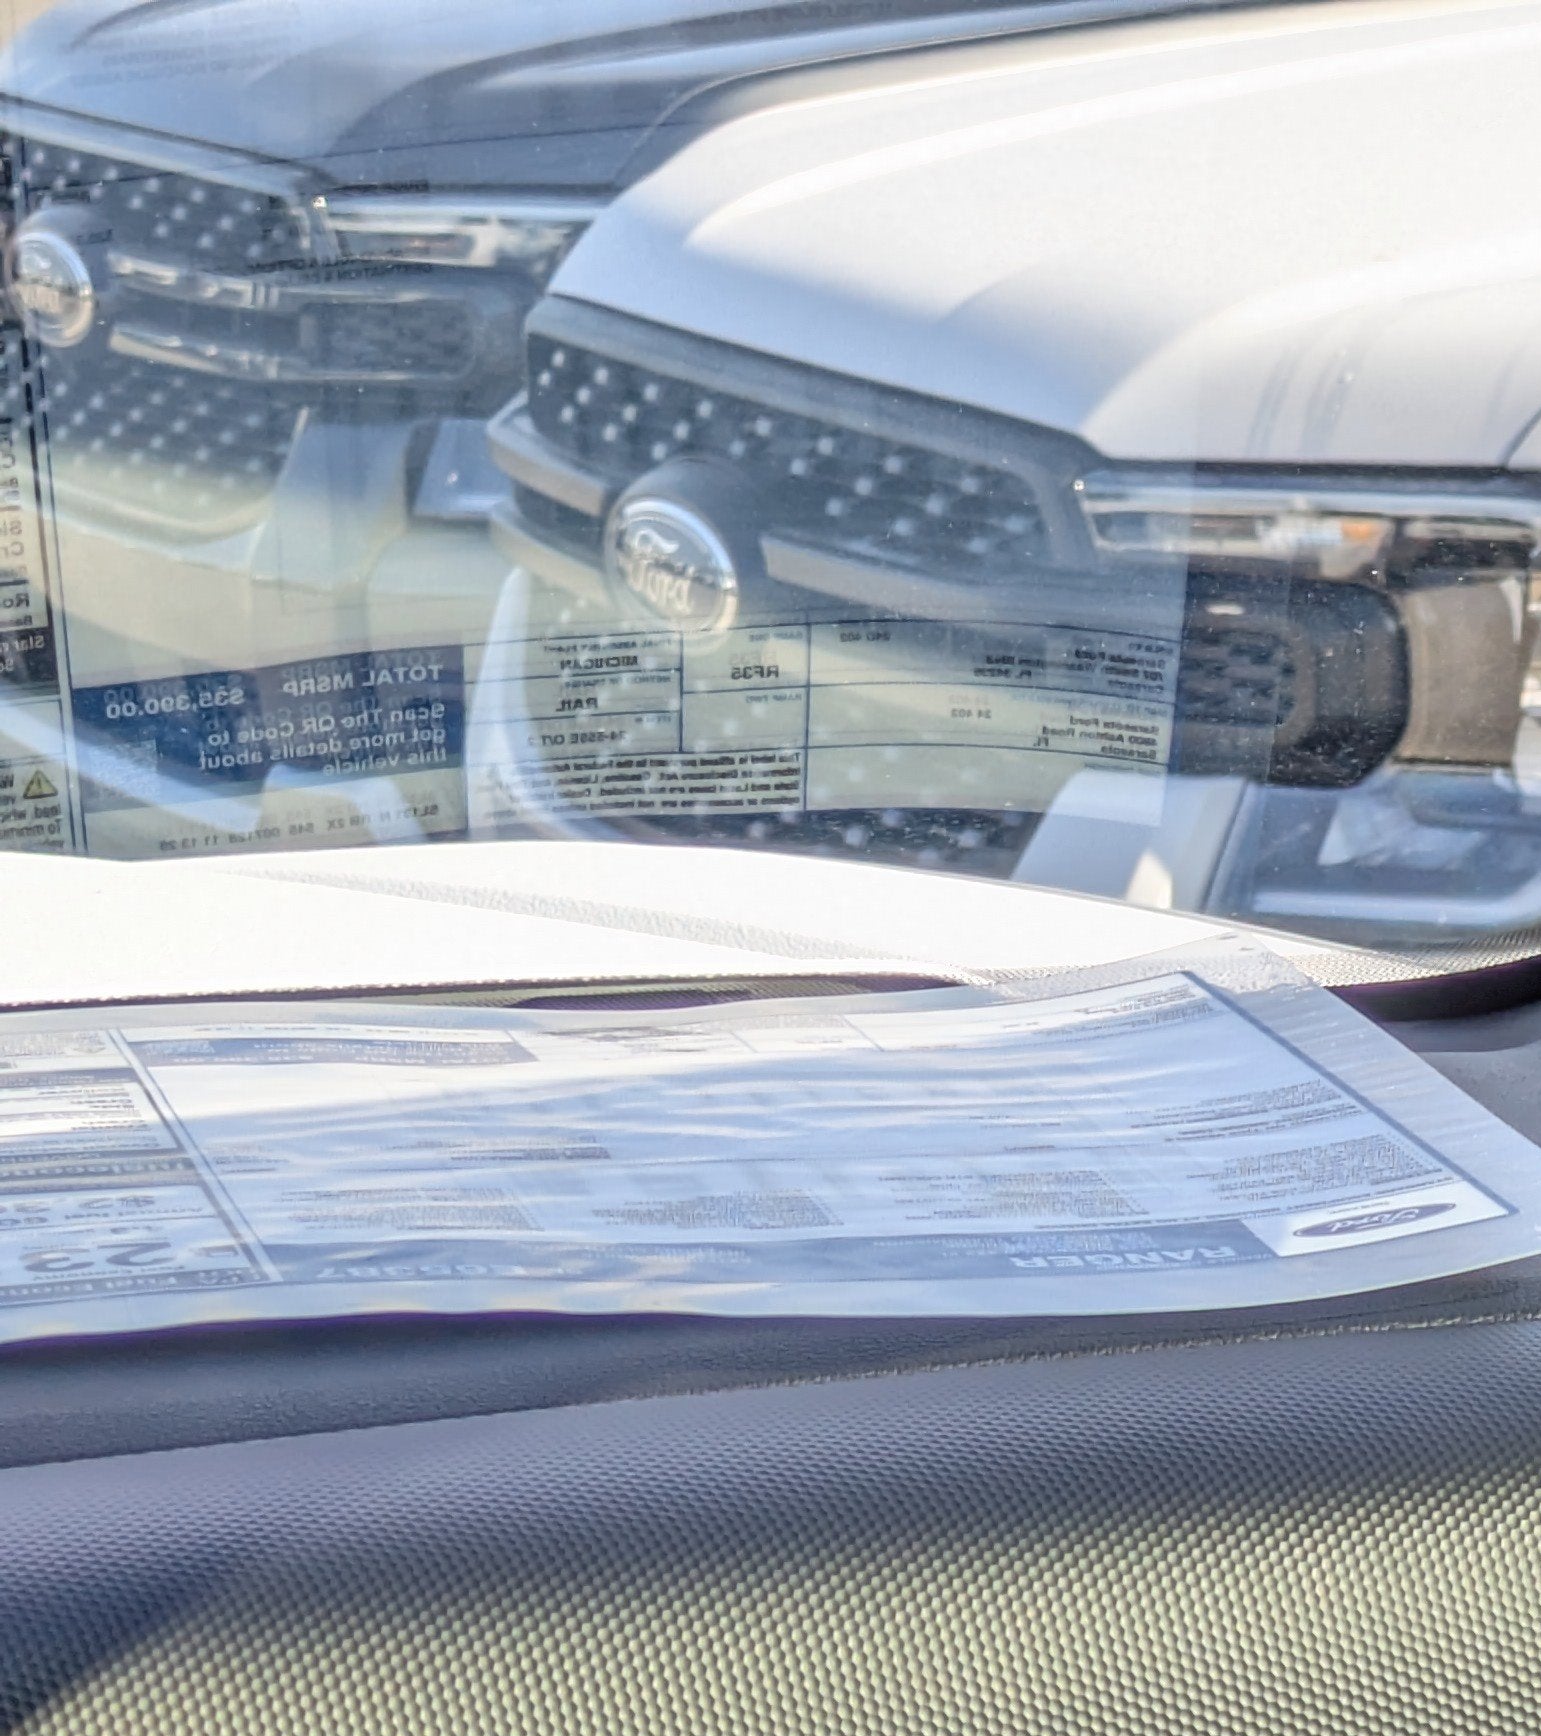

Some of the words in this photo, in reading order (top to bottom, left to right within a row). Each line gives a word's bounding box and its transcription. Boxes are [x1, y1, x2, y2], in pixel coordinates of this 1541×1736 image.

[1327, 1208, 1419, 1233] Ford
[18, 1241, 177, 1273] 23
[1009, 1245, 1237, 1268] RANGER
